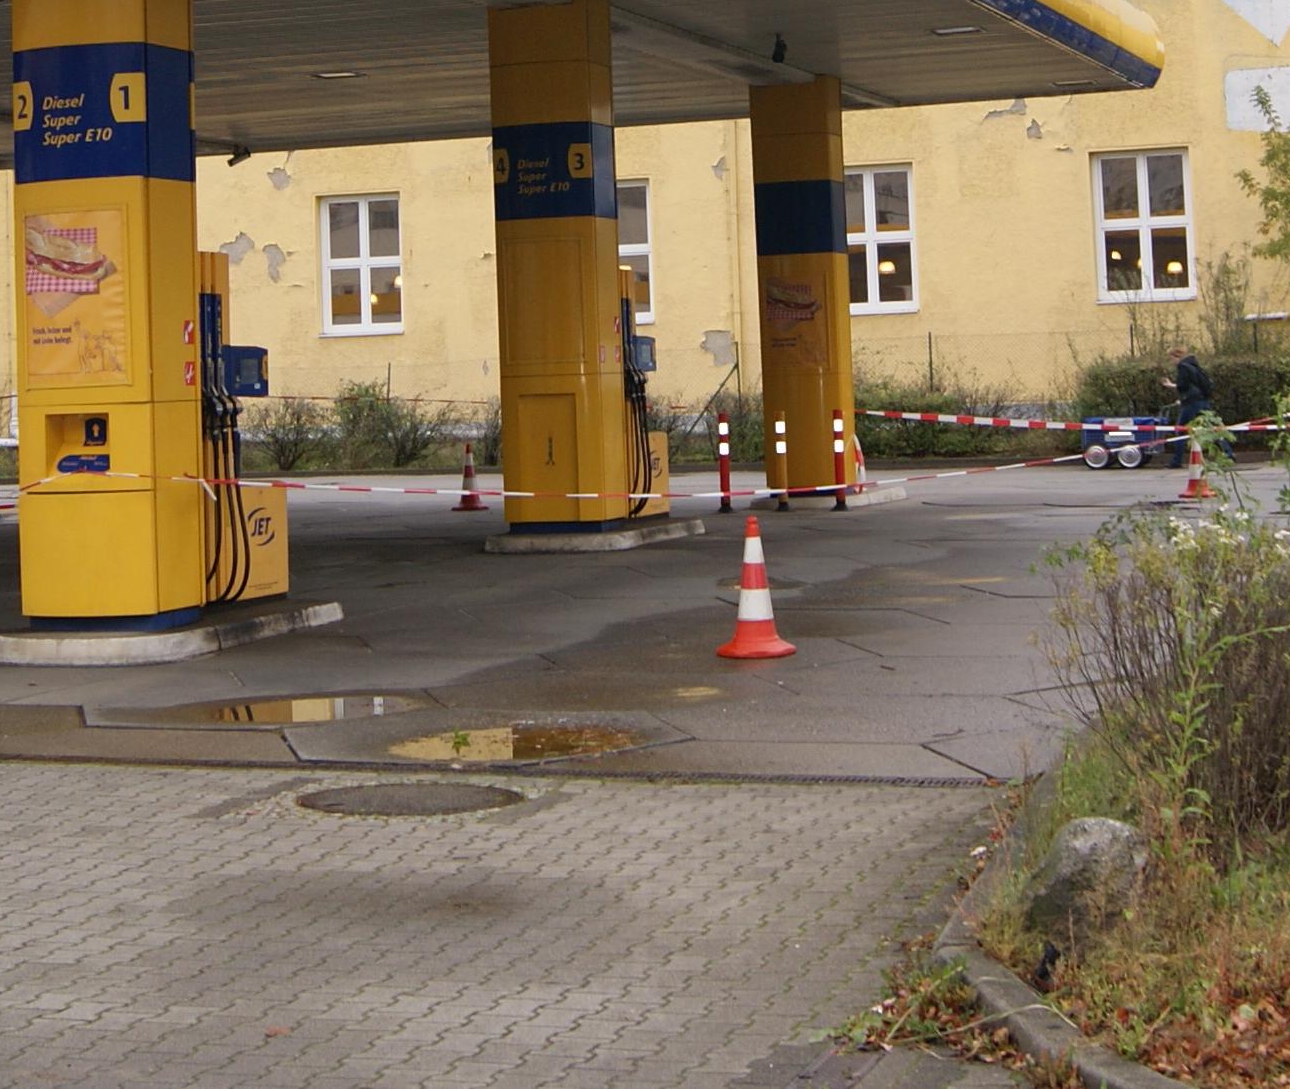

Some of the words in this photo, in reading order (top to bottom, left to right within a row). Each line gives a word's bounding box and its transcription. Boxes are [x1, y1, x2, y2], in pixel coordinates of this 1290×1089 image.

[42, 93, 85, 111] Diesel
[118, 85, 130, 110] 1
[17, 95, 28, 119] 2
[42, 114, 82, 130] Super
[42, 132, 82, 148] Super
[84, 127, 113, 142] E10
[496, 157, 505, 175] 4
[517, 157, 550, 169] Diesel
[573, 153, 585, 170] 3
[517, 172, 547, 184] Super
[517, 185, 547, 196] Super
[251, 516, 272, 537] JET
